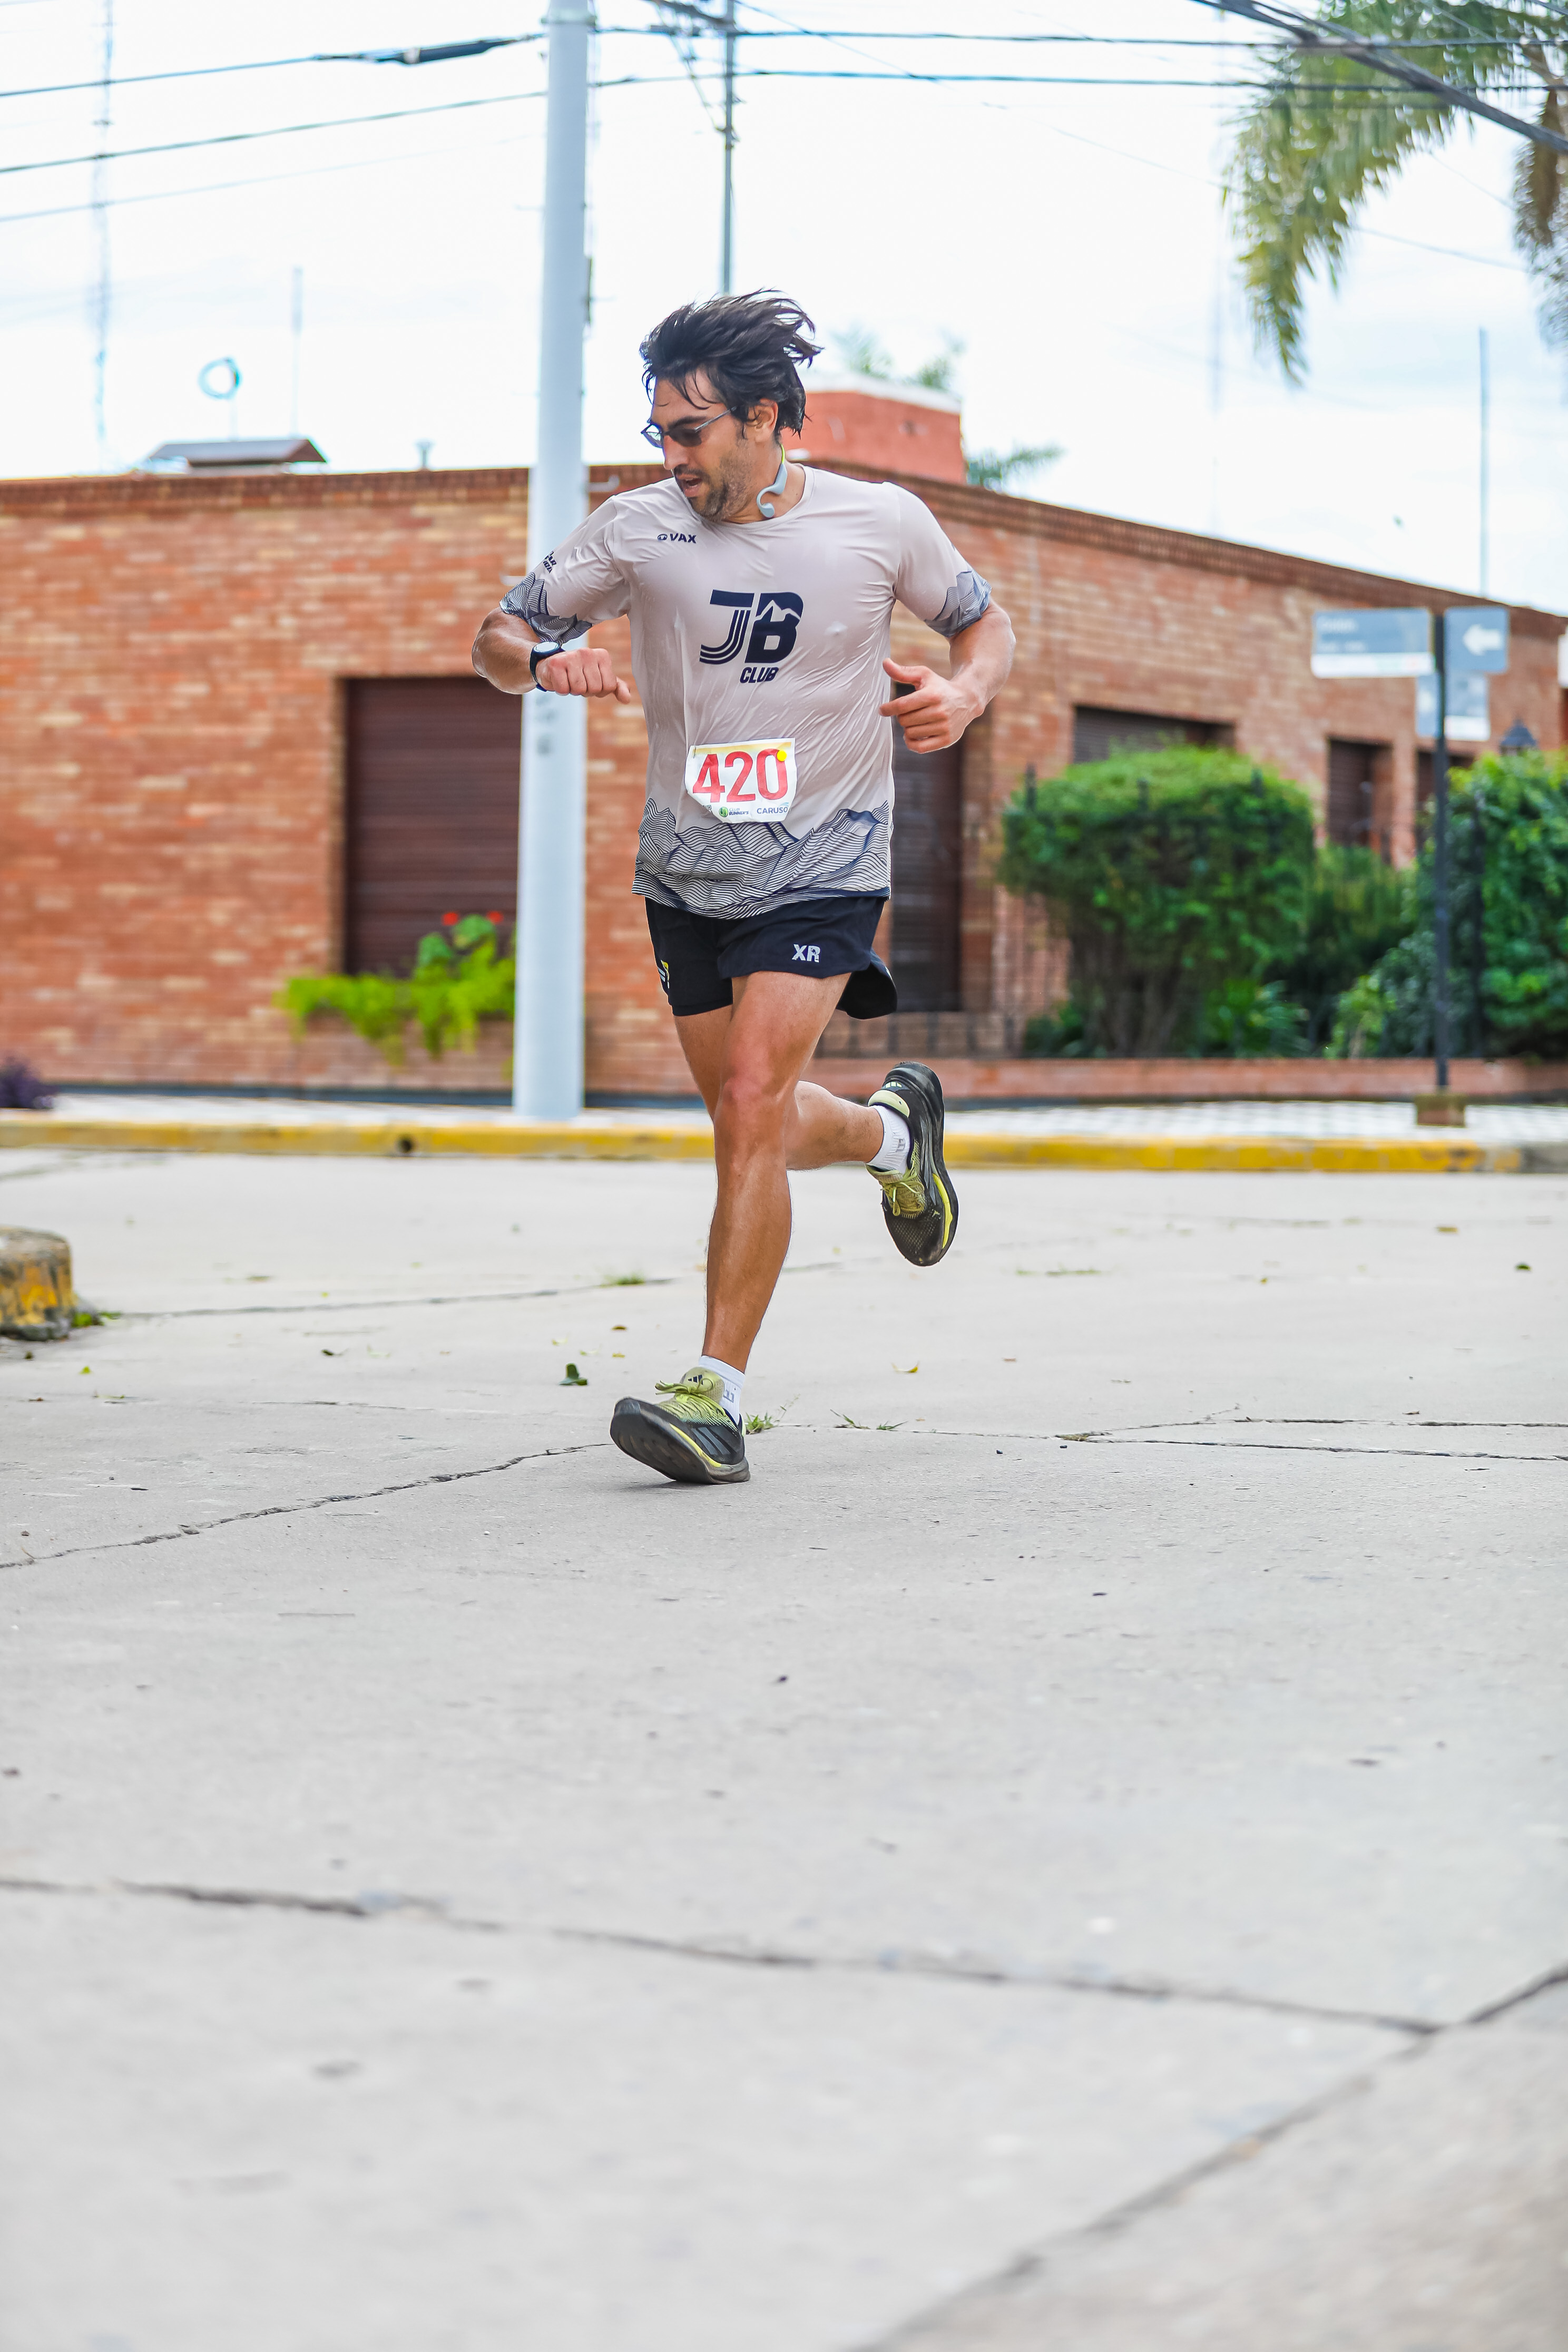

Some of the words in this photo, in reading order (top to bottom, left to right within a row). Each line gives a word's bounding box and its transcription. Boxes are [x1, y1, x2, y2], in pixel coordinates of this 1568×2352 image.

[699, 589, 804, 665] JB
[739, 667, 779, 683] CLUB
[693, 748, 788, 803] 420
[757, 806, 788, 815] CARUSO
[791, 944, 821, 963] XR
